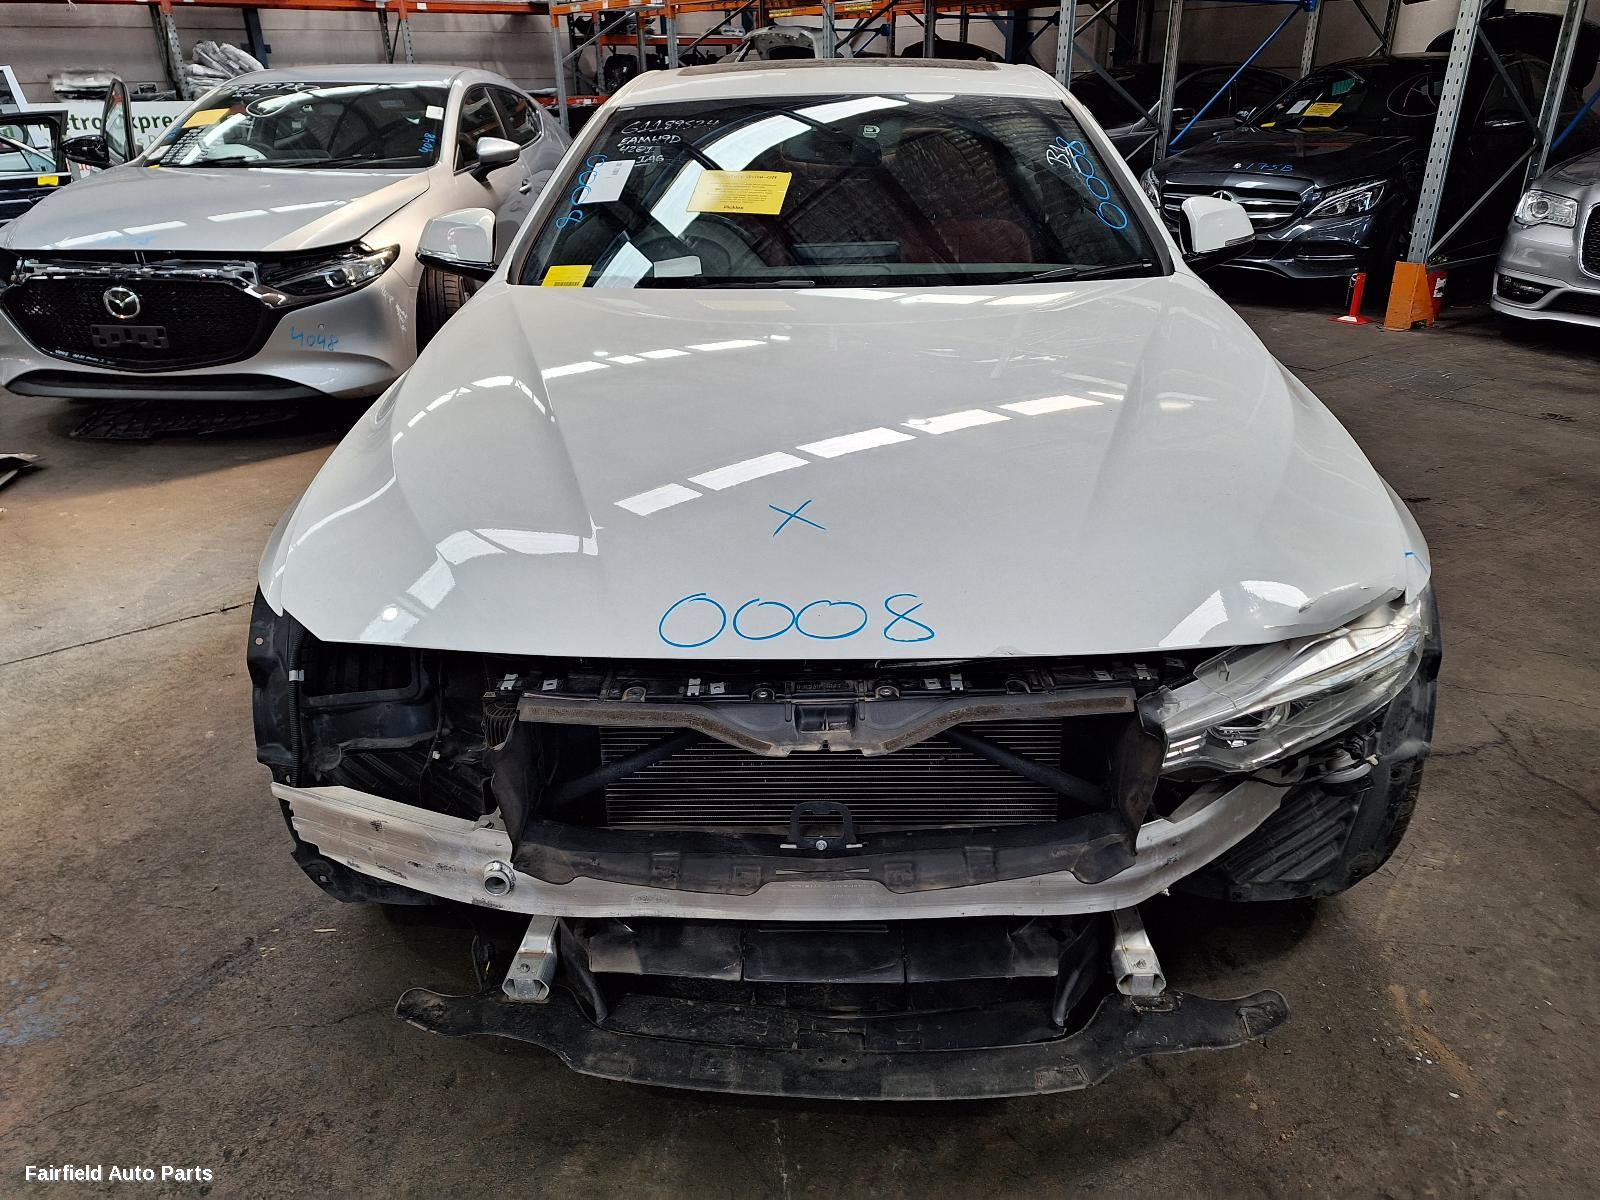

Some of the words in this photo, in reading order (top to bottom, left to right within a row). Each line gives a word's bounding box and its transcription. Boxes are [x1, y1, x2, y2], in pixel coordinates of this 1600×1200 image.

[556, 154, 608, 229] 0008
[1056, 136, 1128, 230] 0008
[289, 326, 339, 351] 4048
[659, 593, 935, 647] 0008
